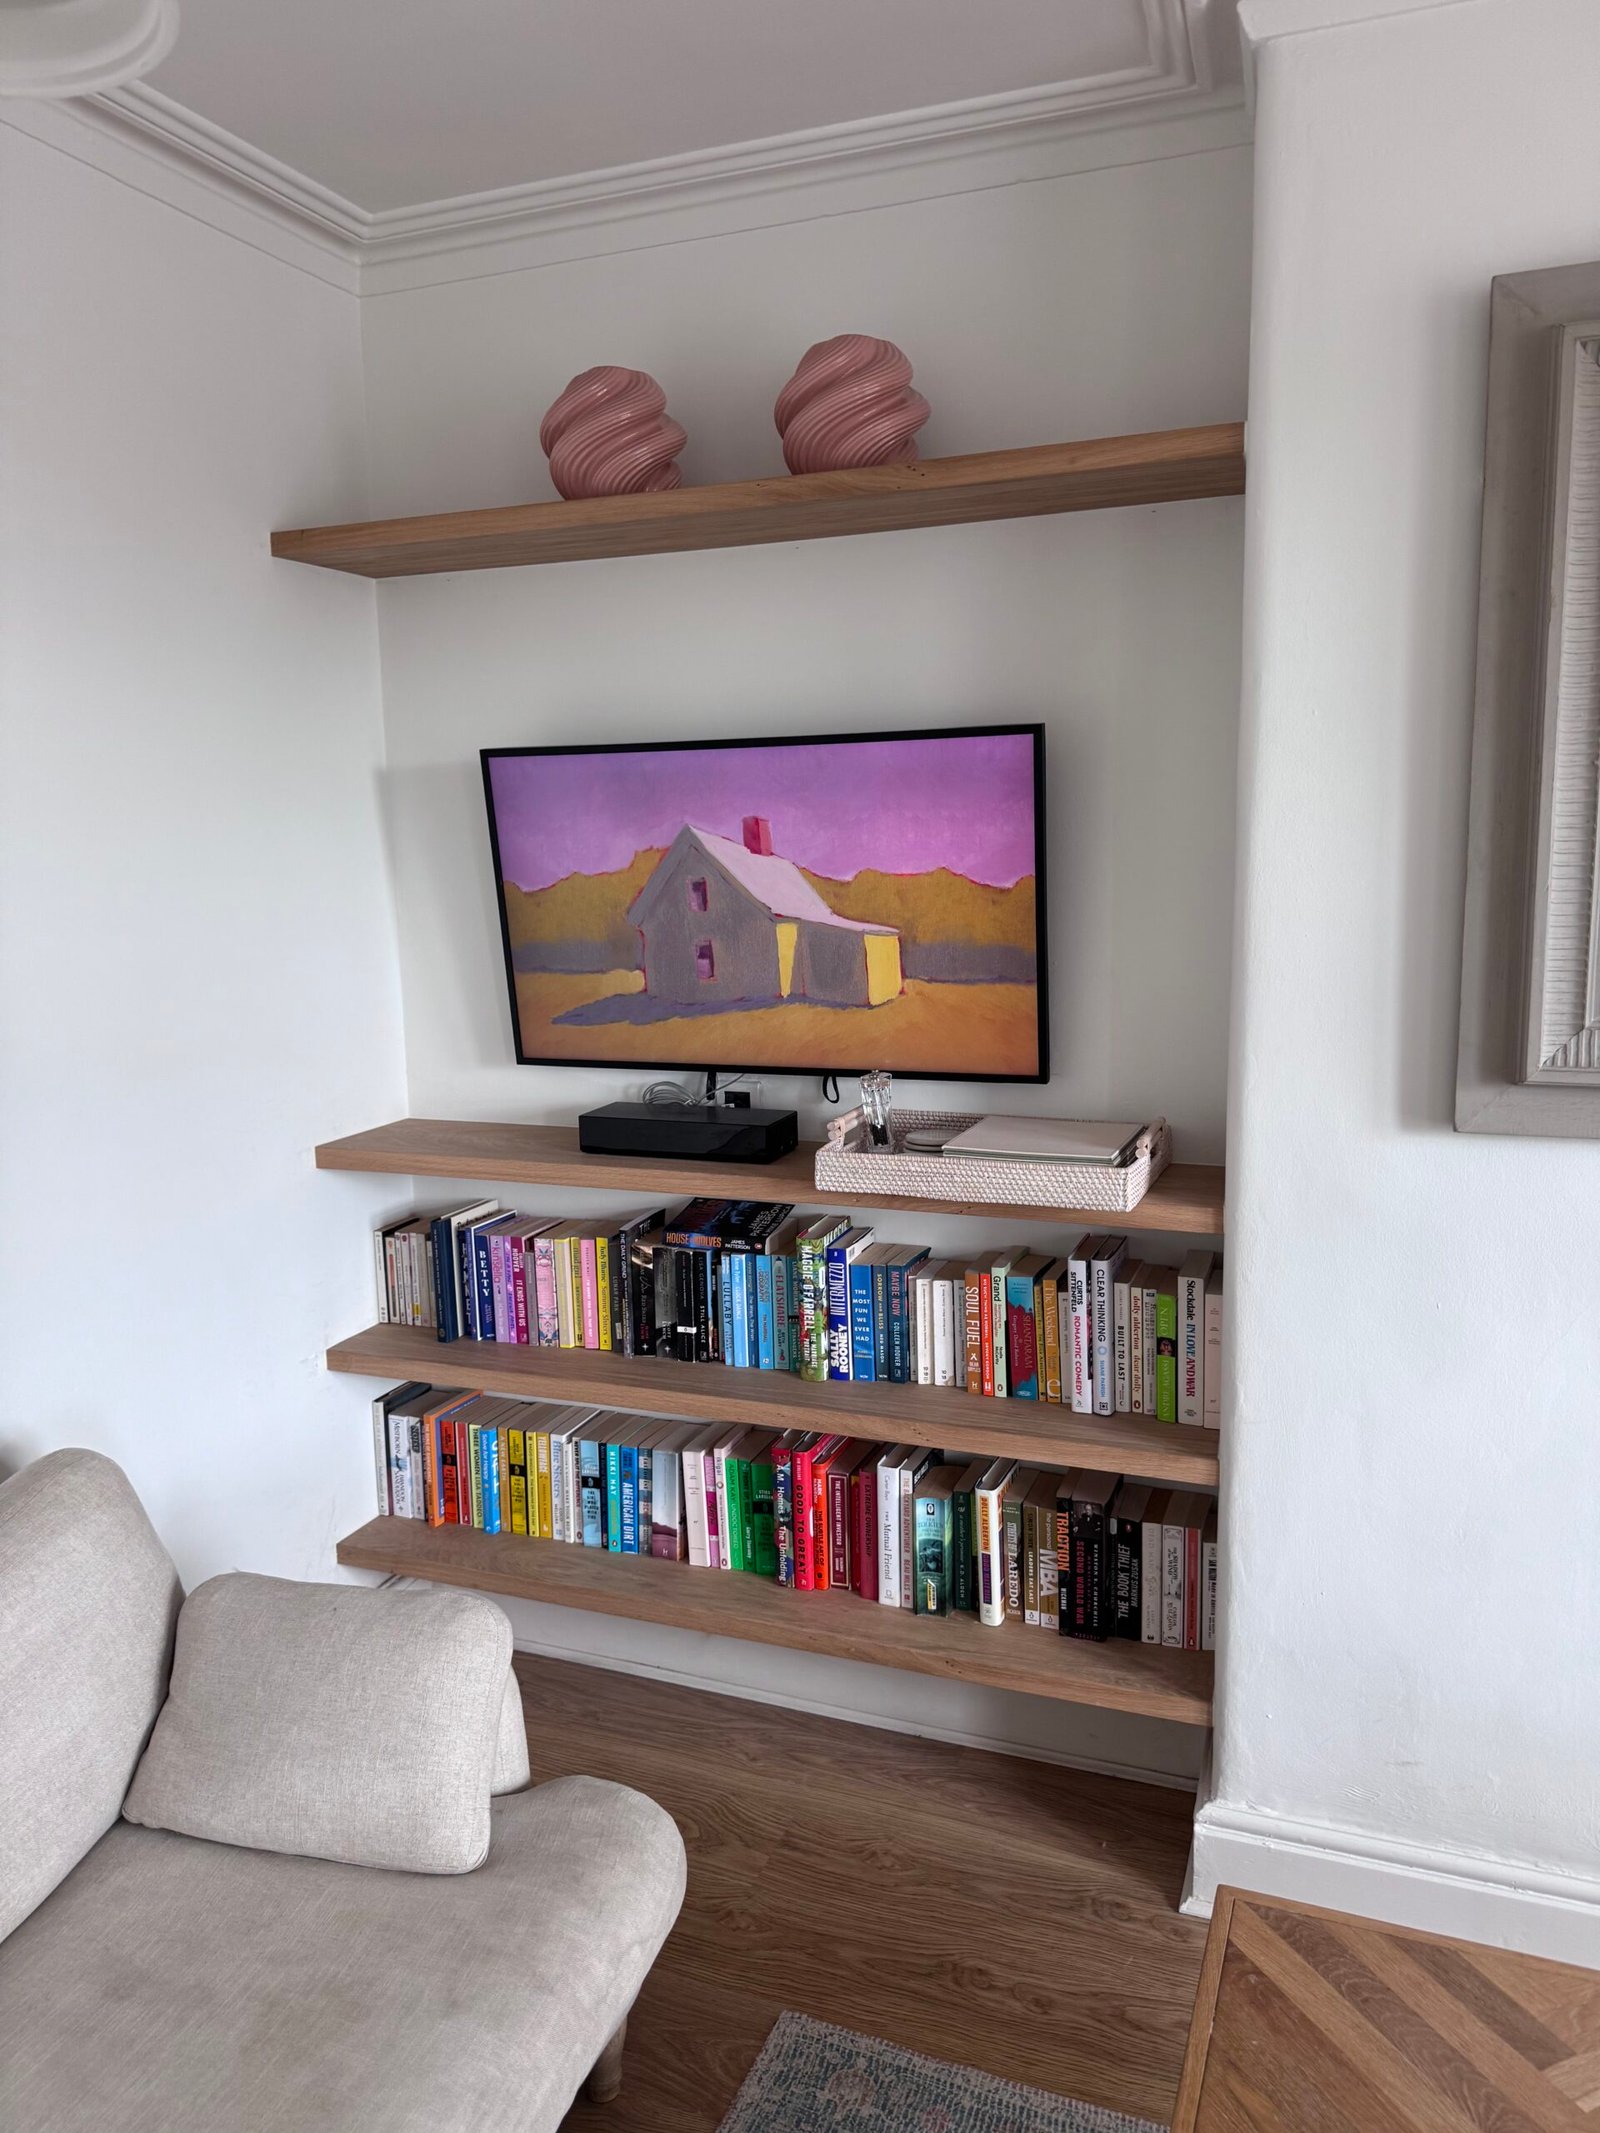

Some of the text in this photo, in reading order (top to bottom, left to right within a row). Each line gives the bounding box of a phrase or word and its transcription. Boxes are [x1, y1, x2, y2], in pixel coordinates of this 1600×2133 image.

[666, 1232, 690, 1245] HOUSE
[480, 1250, 489, 1296] BETTY
[492, 1247, 502, 1283] kinsella
[801, 1246, 815, 1330] MAGGIE O'FARRELL
[828, 1262, 846, 1315] INTERMEZZO
[723, 1281, 732, 1326] LULLABY
[776, 1275, 785, 1327] FLATSHARE
[891, 1271, 901, 1316] MAYBE NOW
[993, 1276, 1001, 1302] Grand
[1045, 1286, 1055, 1302] The
[1096, 1269, 1106, 1342] CLEAR THINKING
[1132, 1296, 1140, 1315] dolly
[1186, 1280, 1196, 1320] Stockdale
[966, 1286, 980, 1348] SOUL FUEL
[1046, 1306, 1056, 1346] Weekend
[1117, 1326, 1125, 1347] BUILT
[830, 1329, 839, 1367] SALLY
[838, 1324, 848, 1373] ROONEY
[1023, 1315, 1032, 1368] SHANTARAM
[1118, 1350, 1124, 1359] TO
[1186, 1324, 1195, 1397] IN LOVE AND WAR
[552, 1440, 561, 1498] Blue Sisters
[776, 1464, 786, 1514] A.M. Homes
[623, 1483, 634, 1545] AMERICAN DIRT
[731, 1504, 739, 1549] UNDOCTORED
[796, 1484, 807, 1575] GOOD TO GREAT
[981, 1498, 989, 1517] DOLLY
[778, 1526, 788, 1581] The Unfolding
[865, 1518, 873, 1557] OWNERSHIP
[883, 1523, 893, 1580] Mutual Friend
[1006, 1522, 1017, 1543] STREETS
[1056, 1512, 1070, 1571] TRACTION
[1008, 1552, 1019, 1607] LAREDO
[1040, 1549, 1058, 1596] MBA
[1076, 1541, 1084, 1624] SECOND WORLD WAR
[1117, 1544, 1130, 1618] THE BOOK THIEF
[1130, 1580, 1138, 1607] MARKUS
